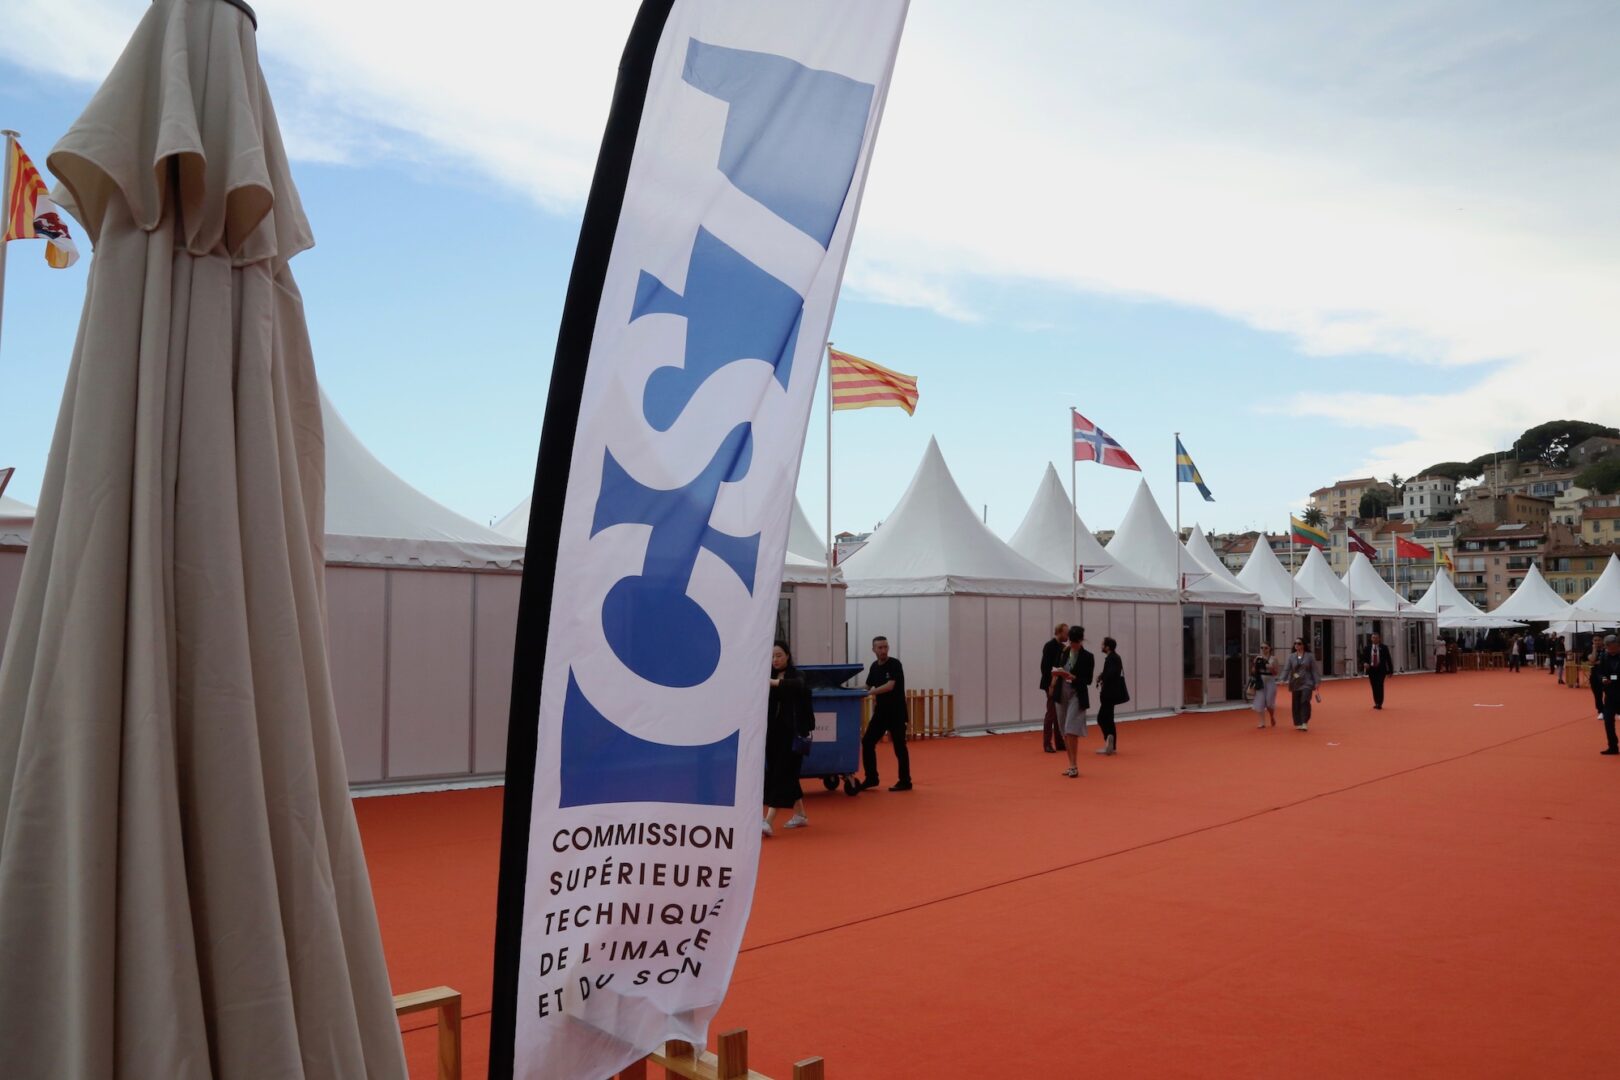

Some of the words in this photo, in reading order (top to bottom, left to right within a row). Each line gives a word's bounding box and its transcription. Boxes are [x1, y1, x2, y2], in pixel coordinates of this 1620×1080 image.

[552, 822, 735, 853] COMMISSION
[550, 856, 733, 896] SUPÉRIEURE
[545, 899, 725, 936] TECHNIQUE
[540, 947, 569, 978] DE
[582, 928, 711, 965] L'IMAGE
[538, 988, 564, 1019] ET
[579, 973, 615, 1001] DU
[632, 957, 702, 986] SON
